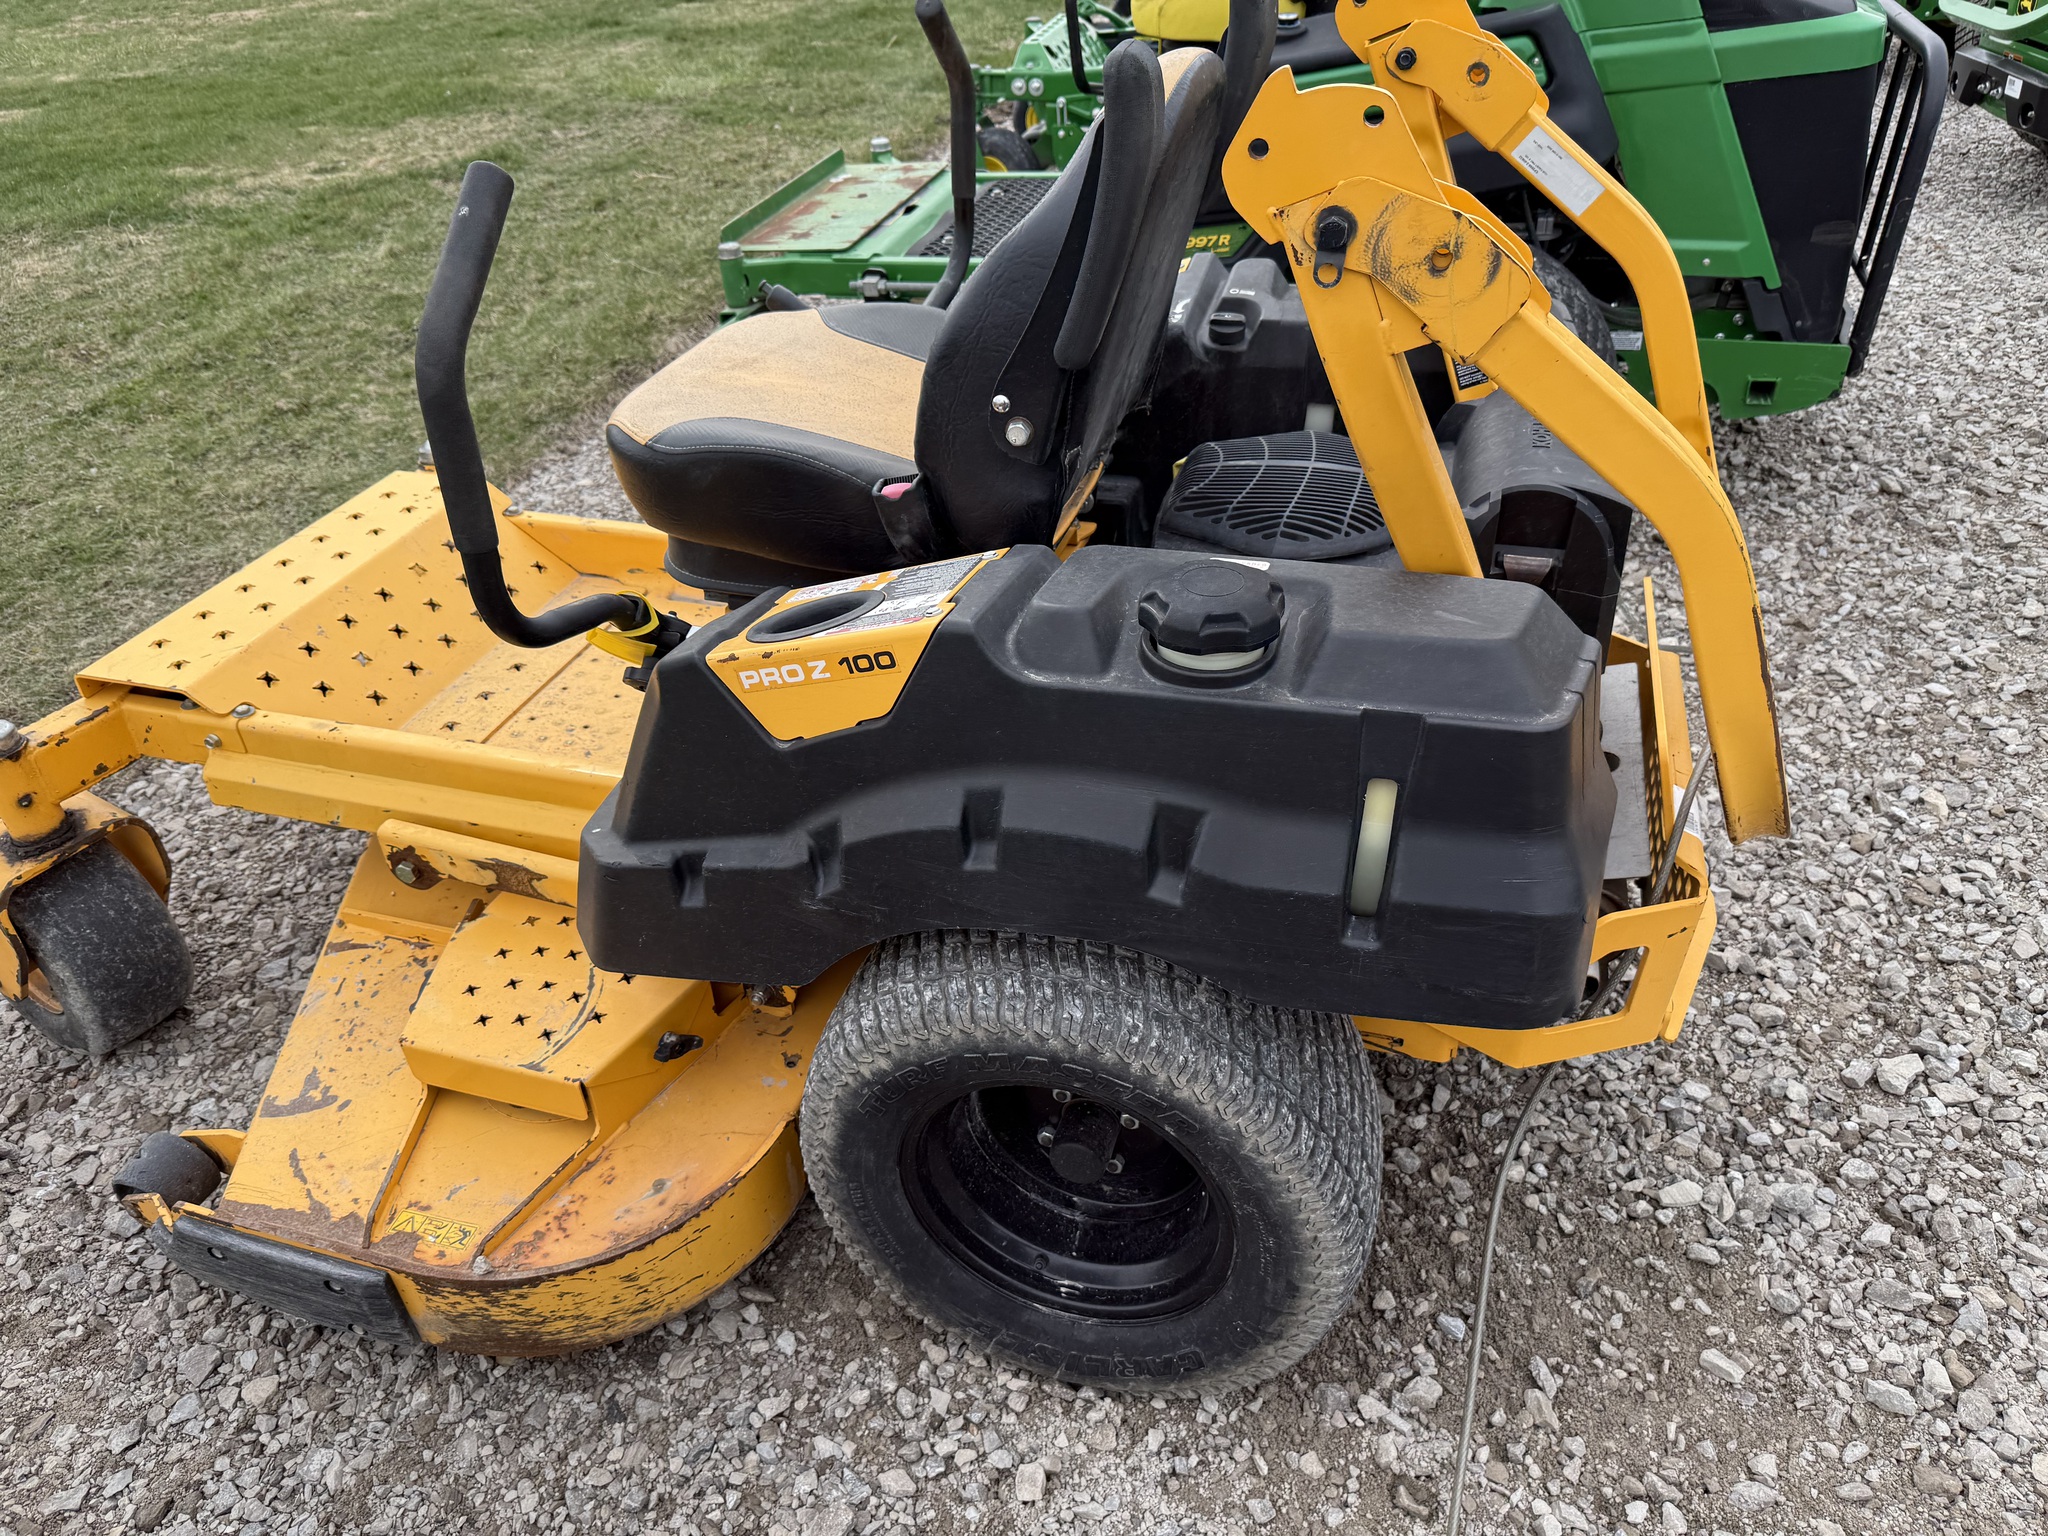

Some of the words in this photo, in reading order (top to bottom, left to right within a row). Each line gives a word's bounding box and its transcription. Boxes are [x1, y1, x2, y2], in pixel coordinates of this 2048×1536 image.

[738, 662, 805, 690] PRO
[808, 660, 831, 680] Z
[838, 650, 897, 675] 100
[857, 1058, 948, 1118] TURF
[964, 1052, 1201, 1136] MASTER
